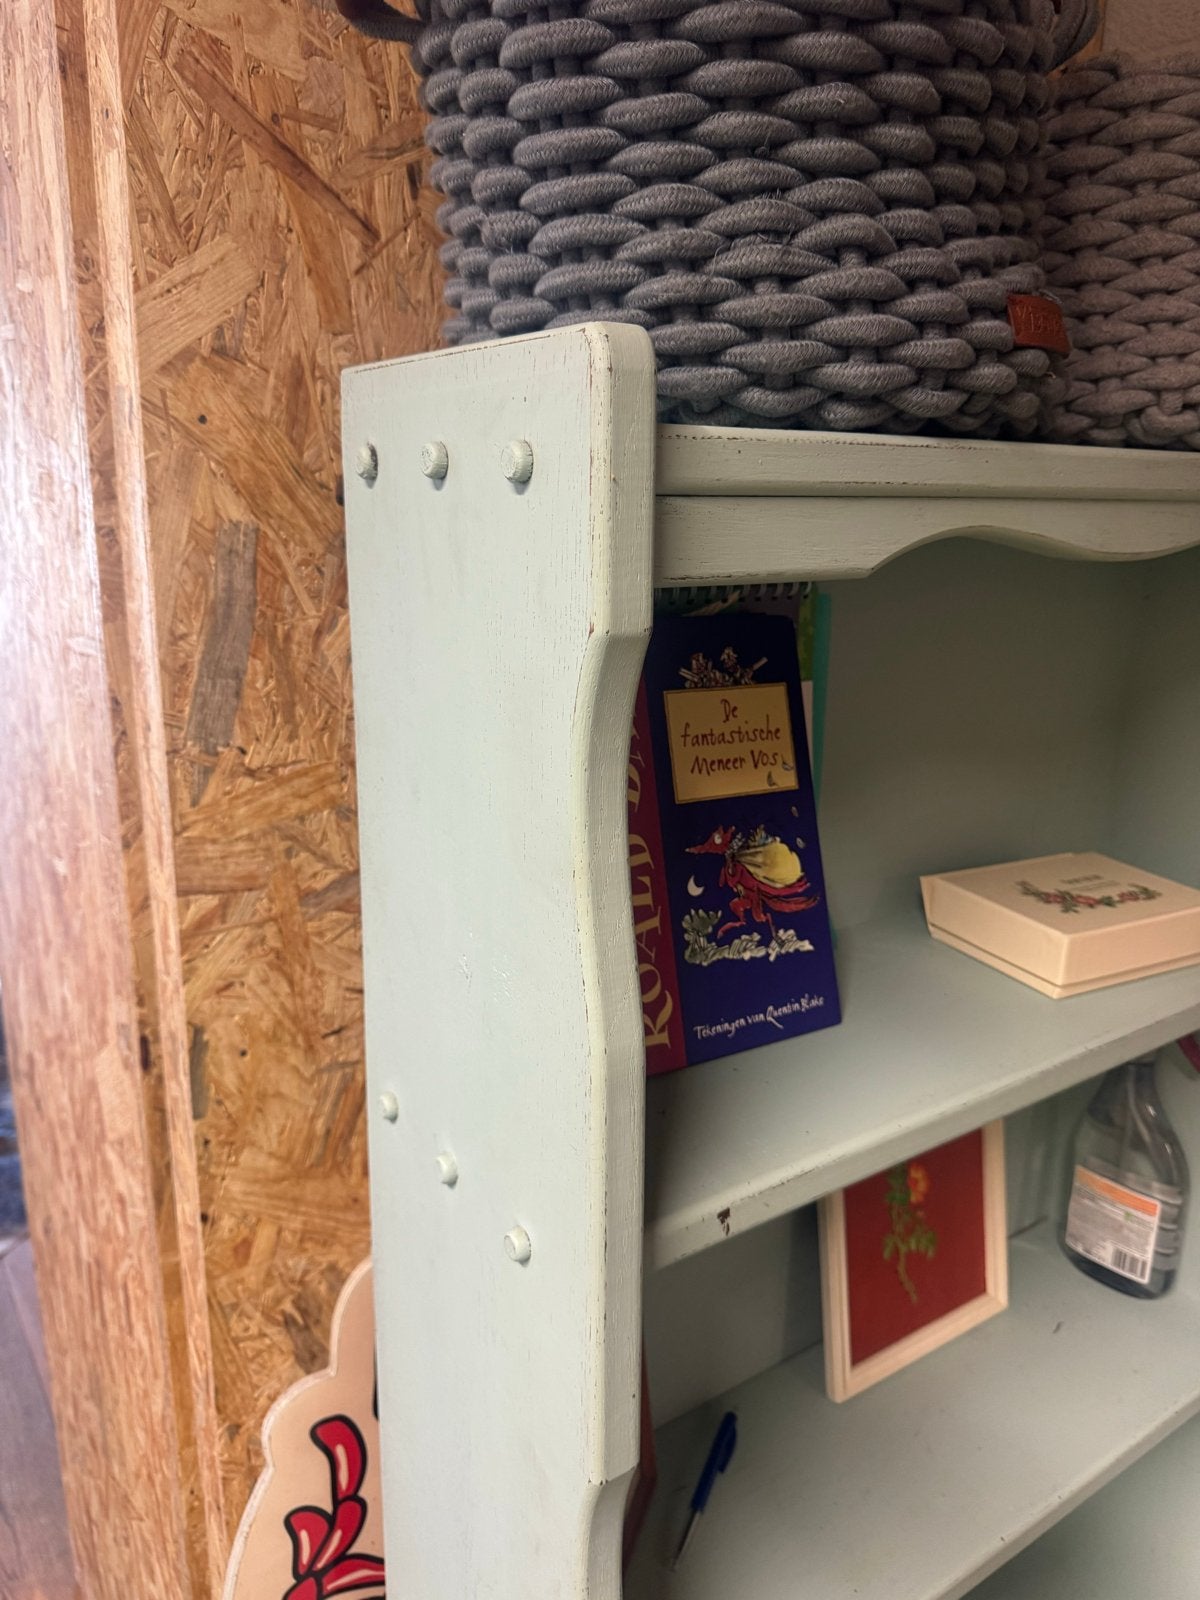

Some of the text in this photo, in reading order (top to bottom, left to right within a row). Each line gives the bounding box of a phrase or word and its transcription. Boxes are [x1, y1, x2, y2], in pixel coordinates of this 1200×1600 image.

[720, 698, 738, 723] De
[681, 714, 781, 747] fantastische
[690, 749, 778, 776] Meneer Vos
[693, 992, 824, 1039] Tekeningen van Quentin Blake
